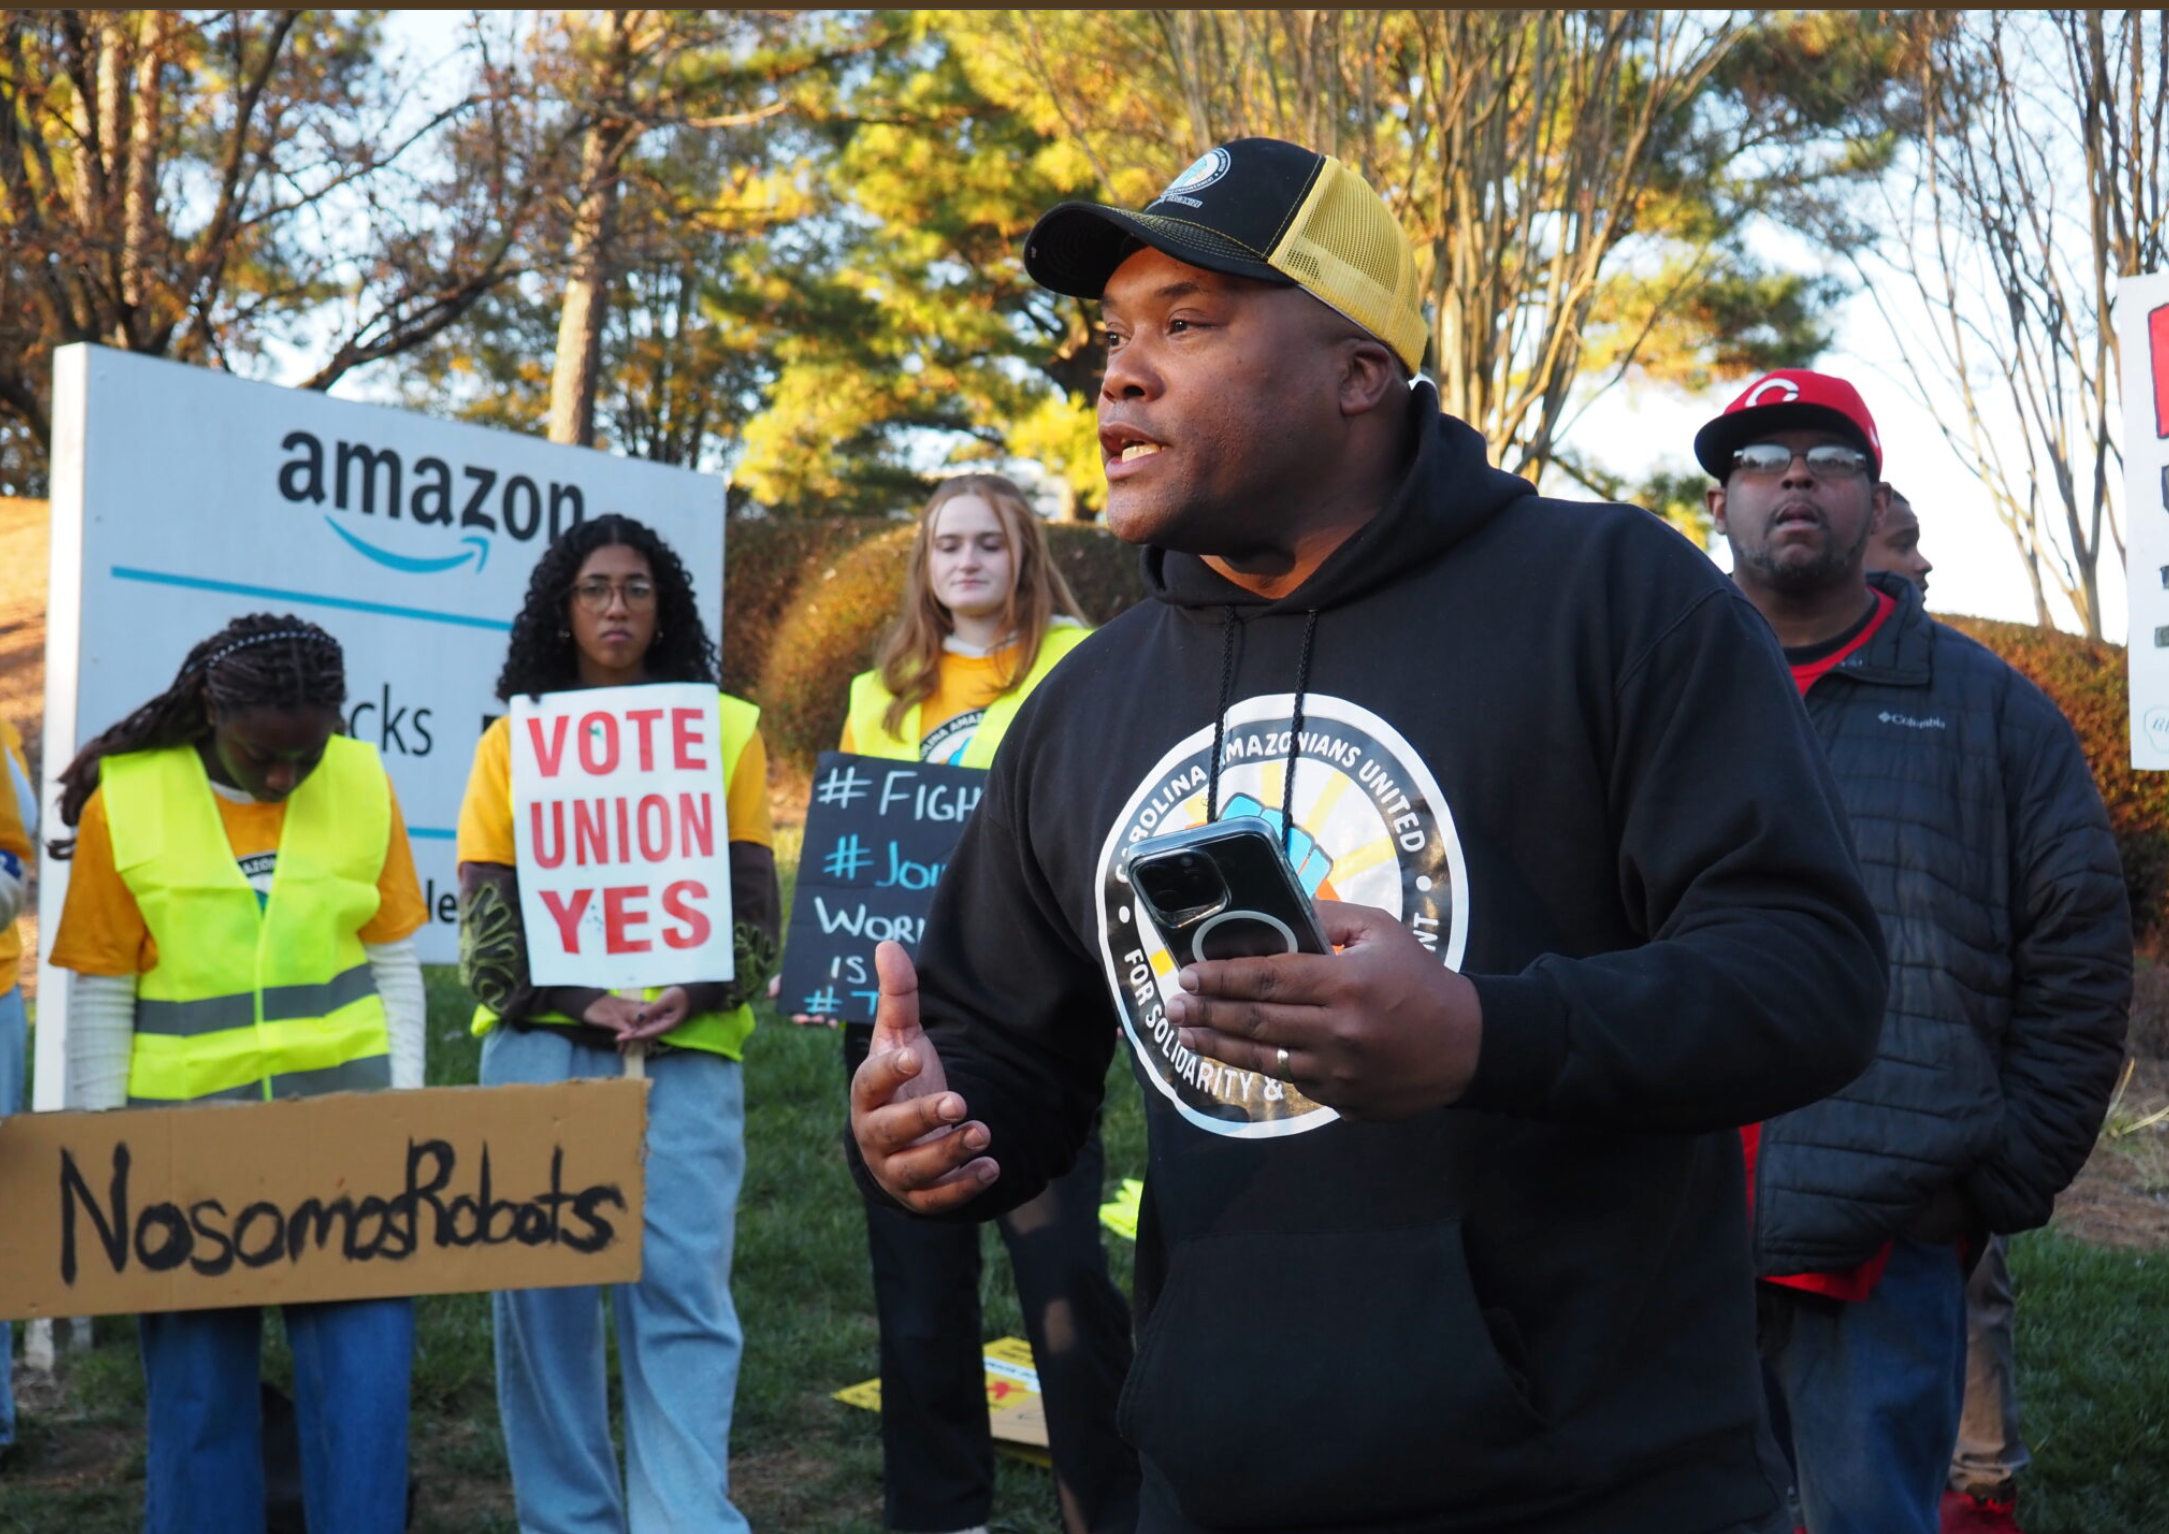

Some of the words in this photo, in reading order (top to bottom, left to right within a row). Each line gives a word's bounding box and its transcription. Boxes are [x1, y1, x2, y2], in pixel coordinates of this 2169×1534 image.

[278, 431, 585, 545] amazon
[351, 682, 433, 756] cks
[526, 707, 708, 777] VOTE
[530, 793, 714, 870] UNION
[1115, 765, 1208, 885] CROLINA
[1221, 731, 1362, 768] MAZONIANS
[1358, 759, 1426, 853] UNITED
[537, 879, 711, 955] YES
[814, 896, 926, 944] WOR
[830, 955, 867, 984] IS
[1124, 948, 1155, 1006] FOR
[1145, 1003, 1255, 1101] SOLIDARITY
[1264, 1075, 1284, 1100] &
